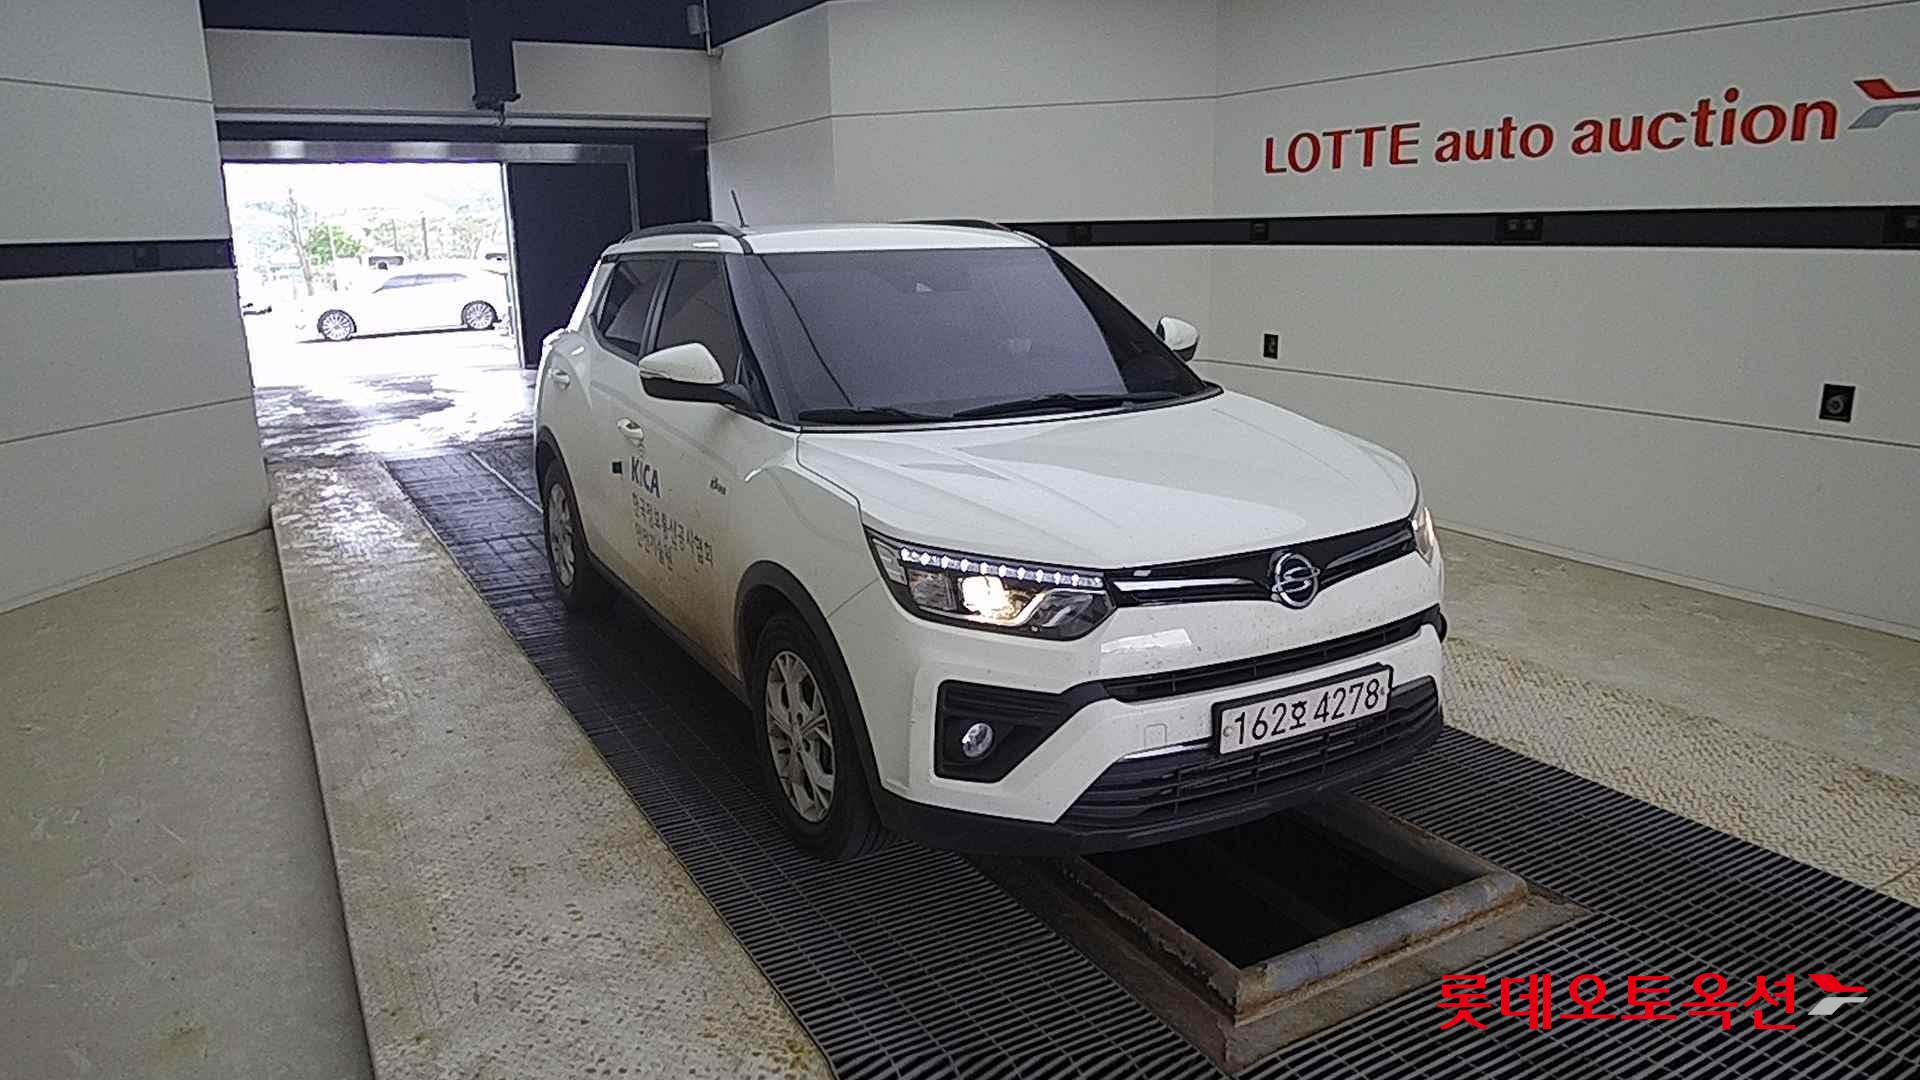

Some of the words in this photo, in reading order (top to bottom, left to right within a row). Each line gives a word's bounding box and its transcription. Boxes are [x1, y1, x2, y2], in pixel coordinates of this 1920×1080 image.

[1264, 122, 1422, 175] LOTTE
[1434, 116, 1555, 163] auto
[1570, 87, 1839, 155] auction
[631, 456, 661, 498] KICA
[1234, 701, 1307, 745] 162호
[1313, 678, 1380, 723] 4278
